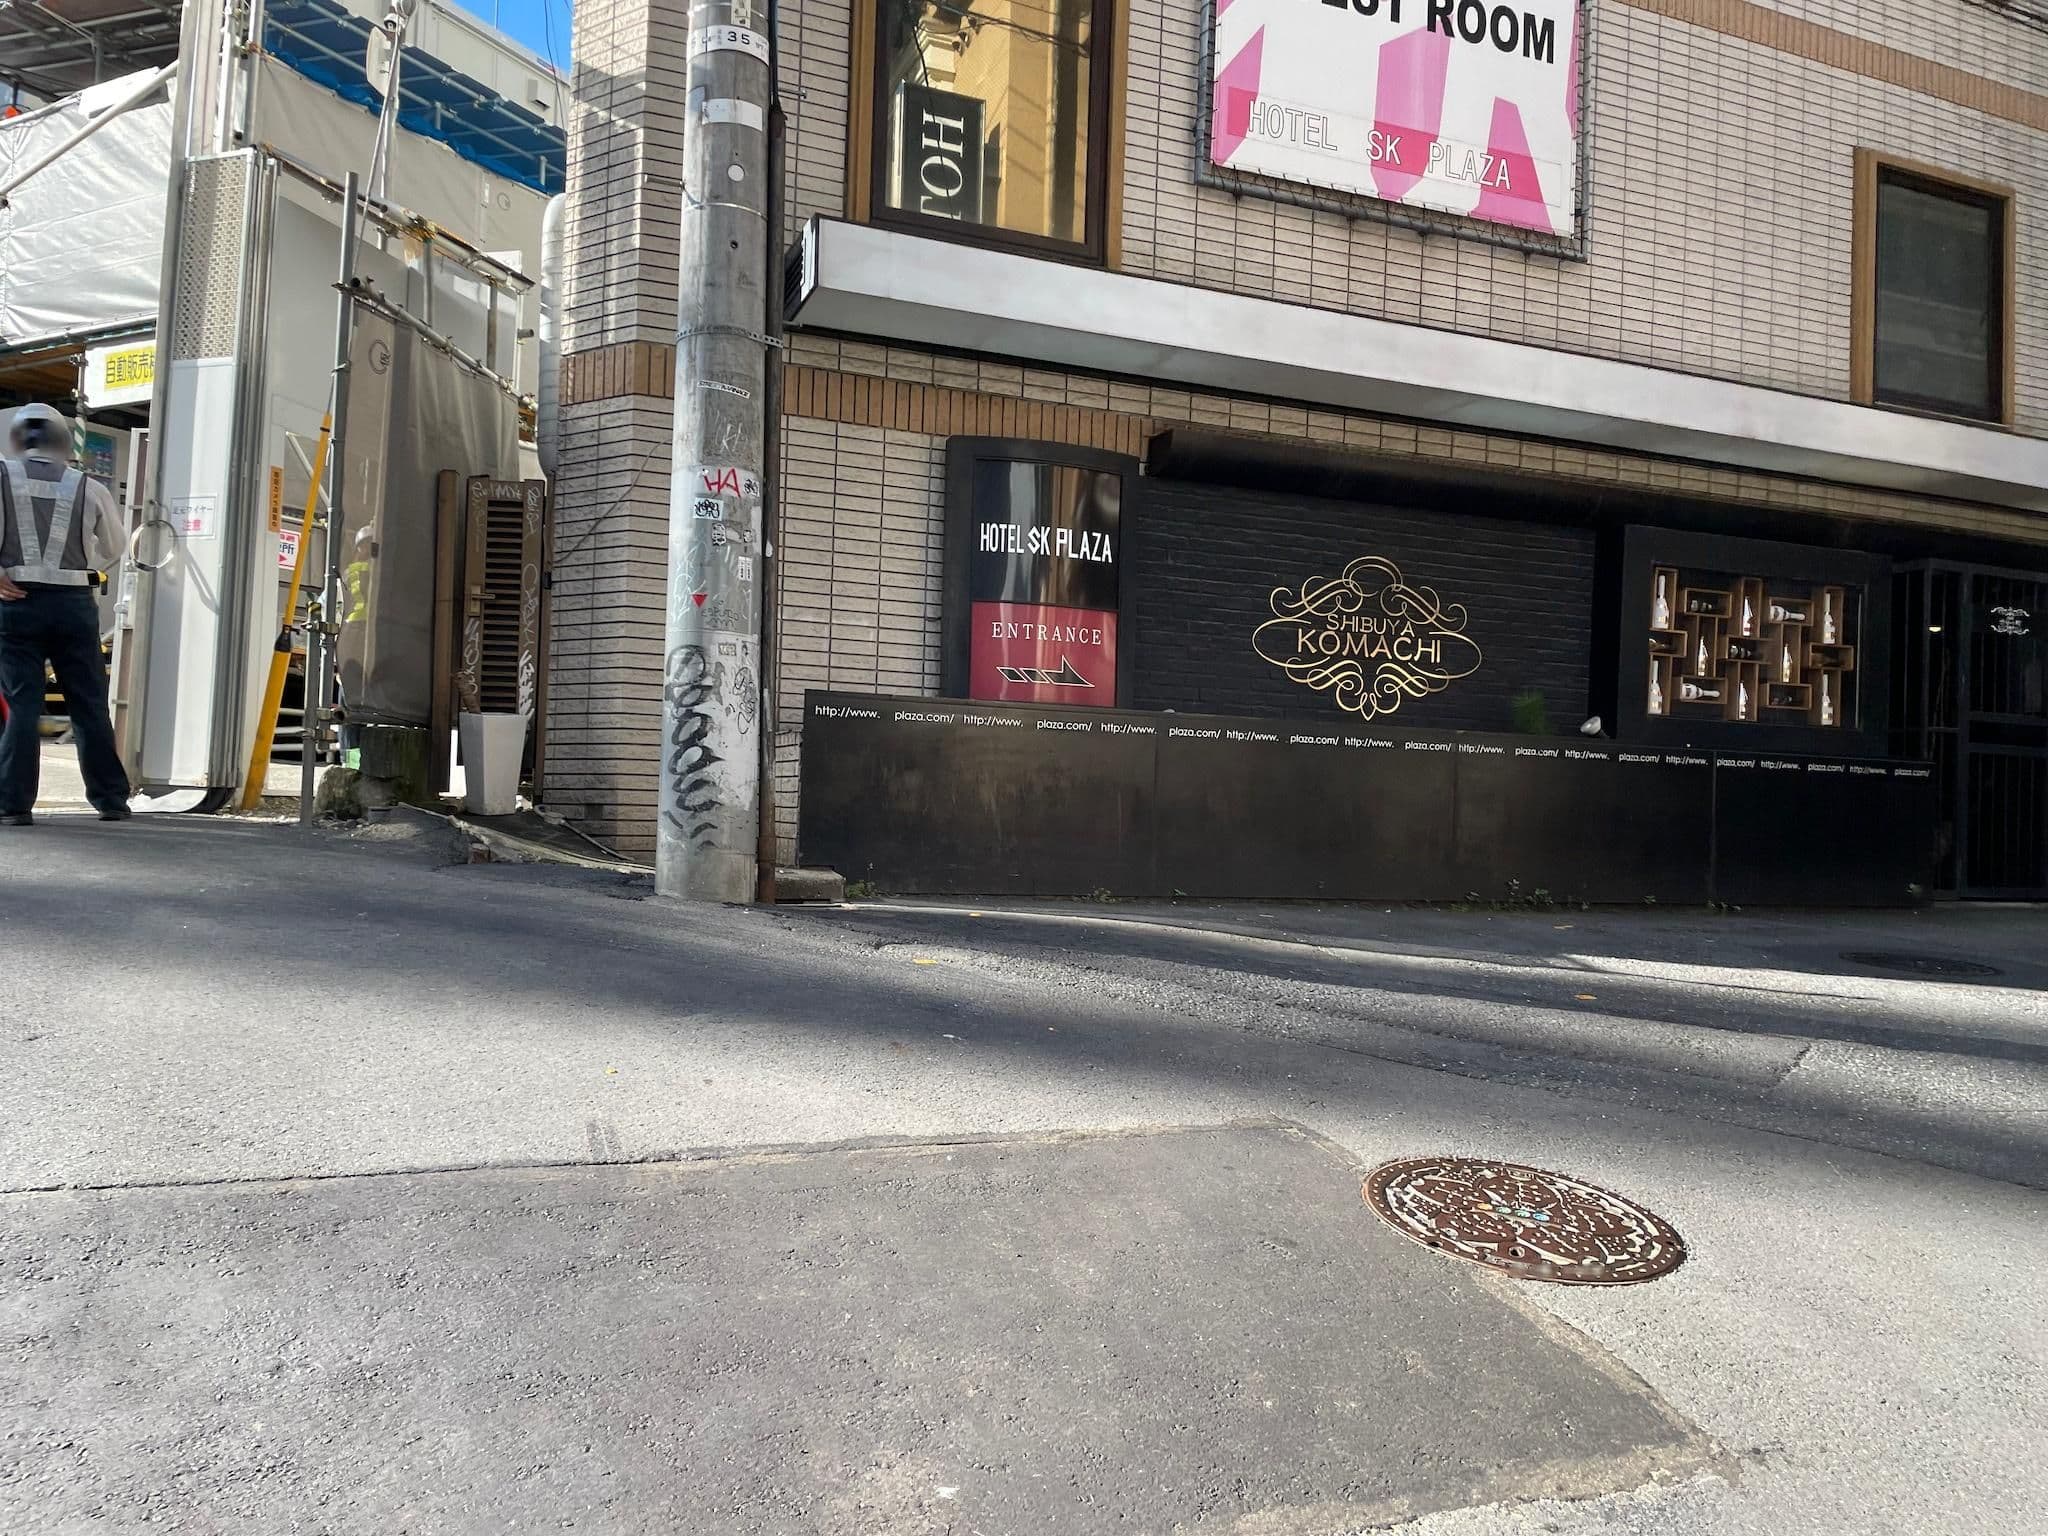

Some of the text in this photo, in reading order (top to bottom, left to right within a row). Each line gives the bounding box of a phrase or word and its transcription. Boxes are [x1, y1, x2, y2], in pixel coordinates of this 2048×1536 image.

[1427, 0, 1554, 64] ROOM
[1249, 100, 1511, 190] HOTEL SK PLAZA
[980, 523, 1113, 563] HOTEL SK PLAZA
[992, 622, 1102, 645] ENTRANCE
[1297, 628, 1441, 663] KOMACHI
[1326, 614, 1415, 637] SHIBUYA
[815, 705, 881, 719] http://www.
[894, 710, 955, 724] plaza.com/
[963, 714, 1024, 728] http://www.
[1036, 719, 1093, 732] plaza.com/
[1100, 722, 1157, 735] http://www.
[1168, 726, 1222, 739] plaza.com/
[1226, 729, 1279, 742] http://www.
[1290, 734, 1340, 746] plaza.com/
[1344, 736, 1395, 748] http://www.
[1404, 740, 1452, 752] plaza.com/
[1458, 743, 1506, 754] http://www.
[1514, 746, 1559, 758] plaza.com/
[1564, 749, 1610, 760] http://www.
[1618, 752, 1661, 764] plaza.com/
